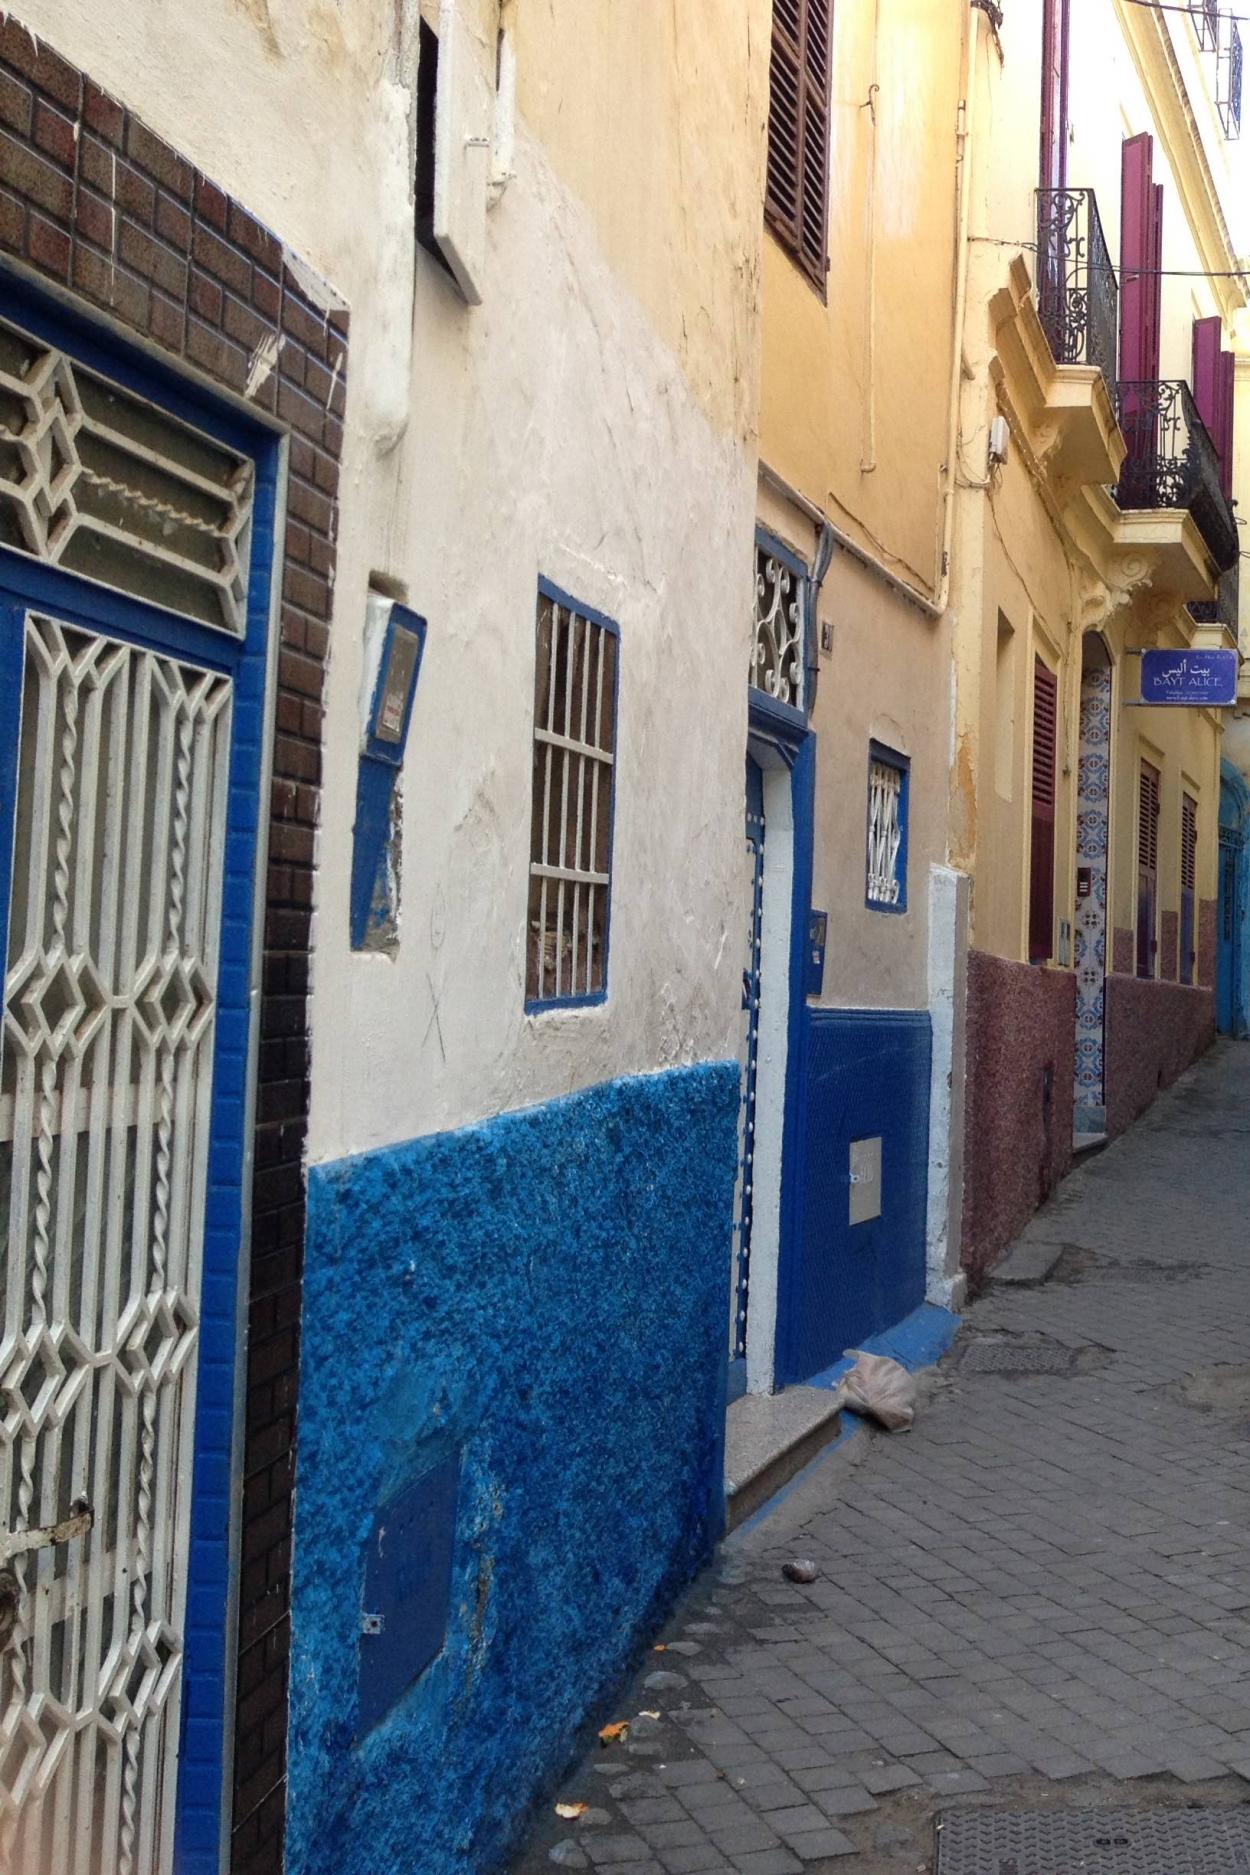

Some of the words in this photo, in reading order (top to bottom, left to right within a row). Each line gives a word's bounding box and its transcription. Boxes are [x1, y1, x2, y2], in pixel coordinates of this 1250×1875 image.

[1190, 664, 1210, 677] بيت
[1153, 676, 1186, 687] BAYT
[1188, 677, 1223, 687] ALICE
